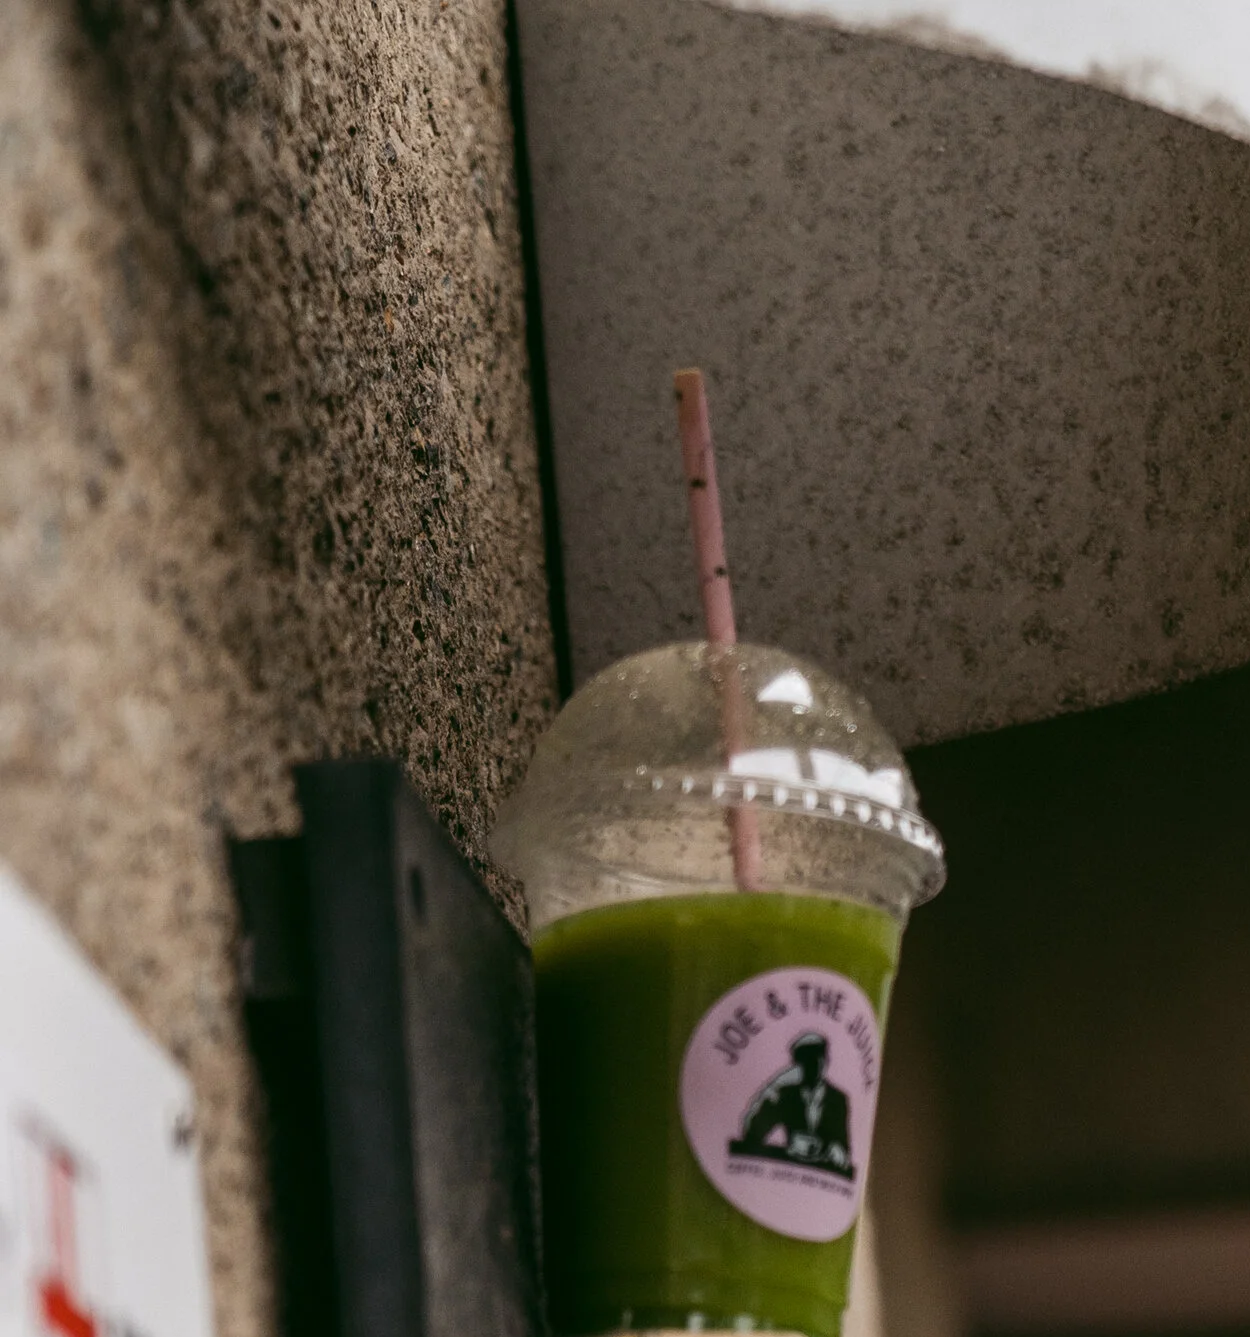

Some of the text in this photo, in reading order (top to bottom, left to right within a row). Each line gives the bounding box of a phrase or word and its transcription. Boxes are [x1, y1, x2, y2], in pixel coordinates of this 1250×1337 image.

[714, 1004, 763, 1065] JOE
[764, 986, 789, 1021] &
[797, 981, 846, 1022] THE
